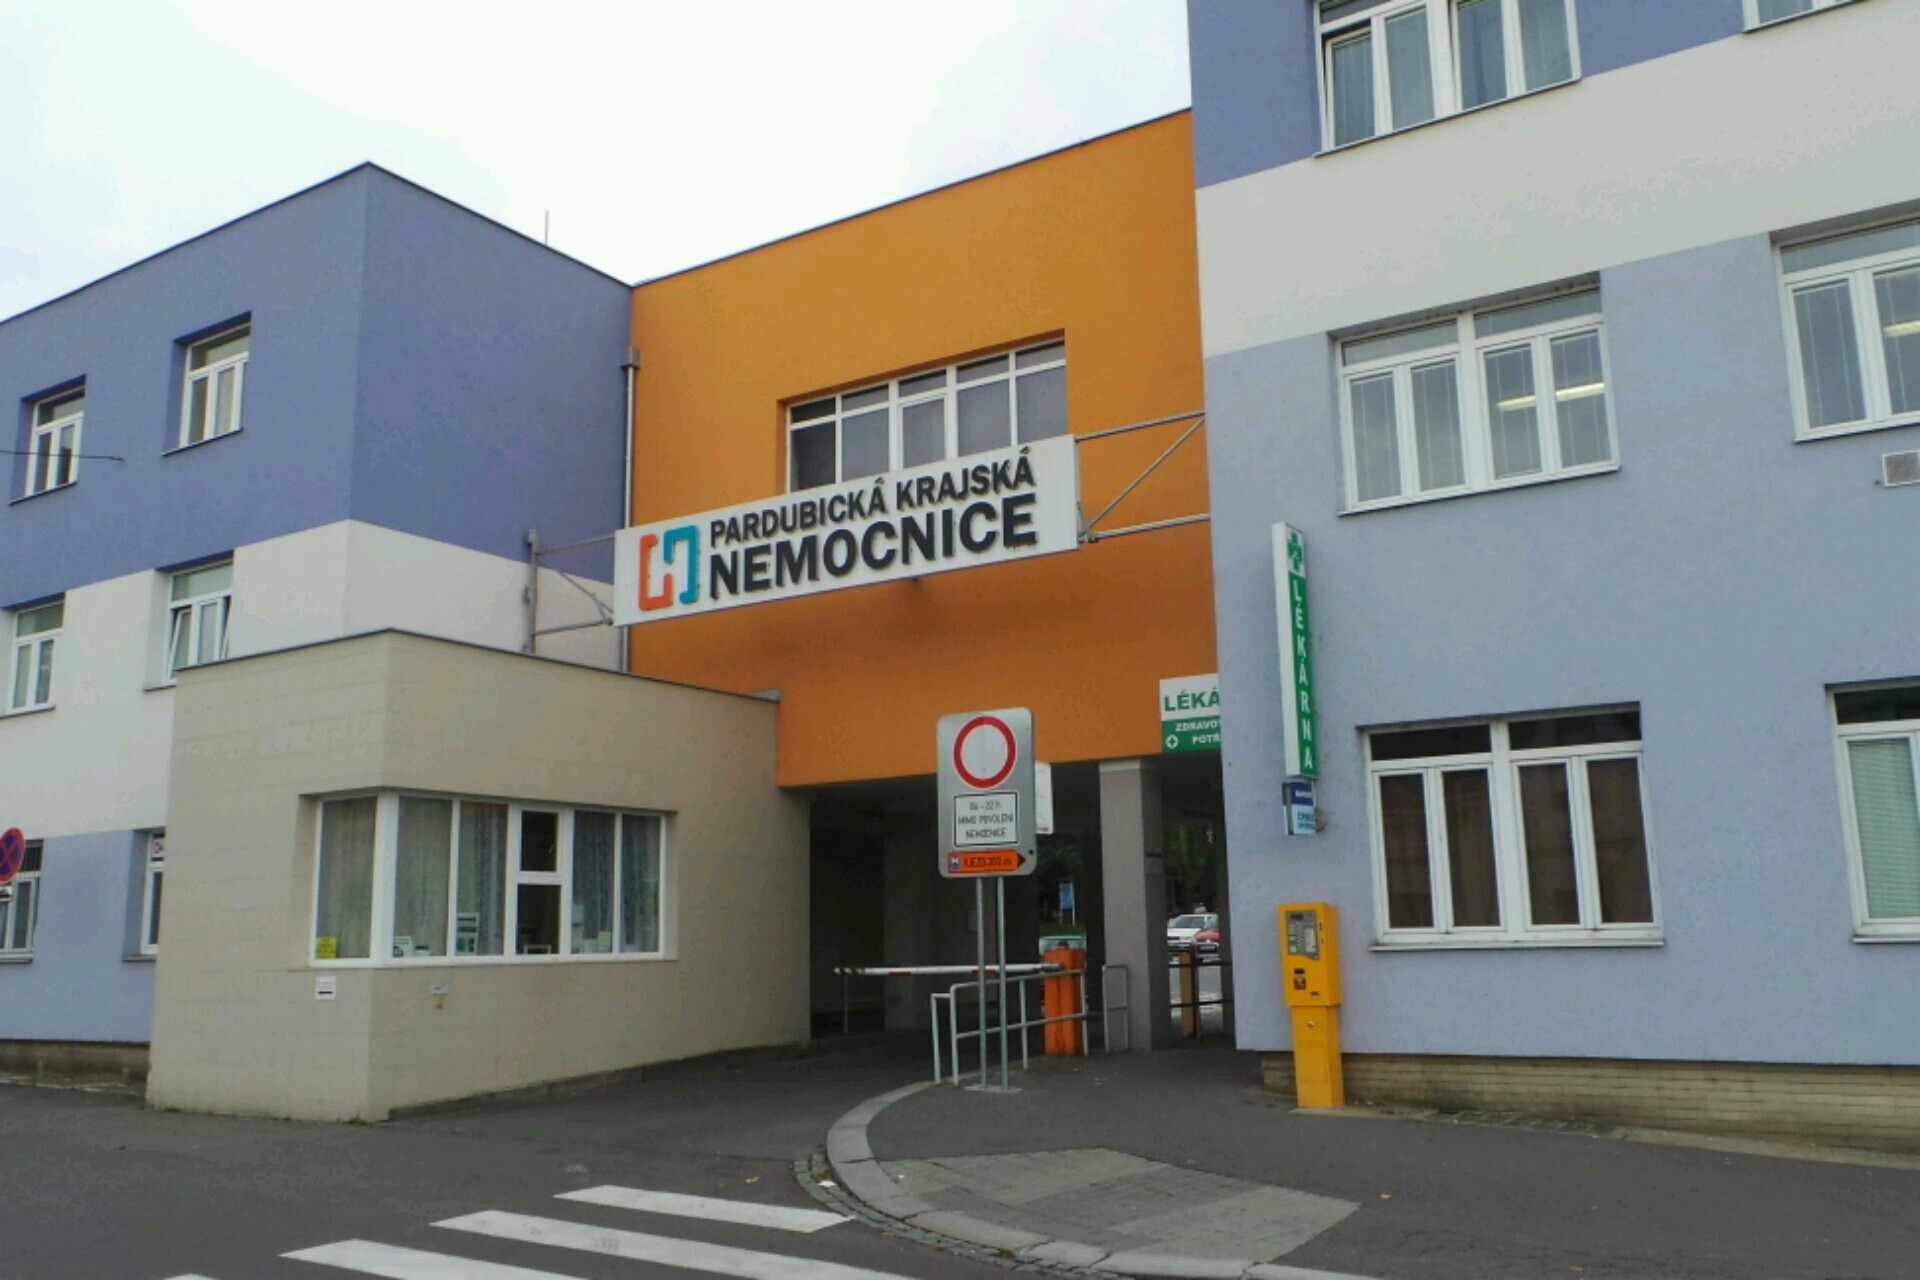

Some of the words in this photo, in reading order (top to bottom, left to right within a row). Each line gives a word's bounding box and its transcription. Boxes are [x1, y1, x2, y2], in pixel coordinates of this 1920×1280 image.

[709, 493, 1037, 600] NEMOCNICE
[710, 476, 887, 548] PARDUBICKÁ
[896, 447, 1036, 510] KRAJSKÁ
